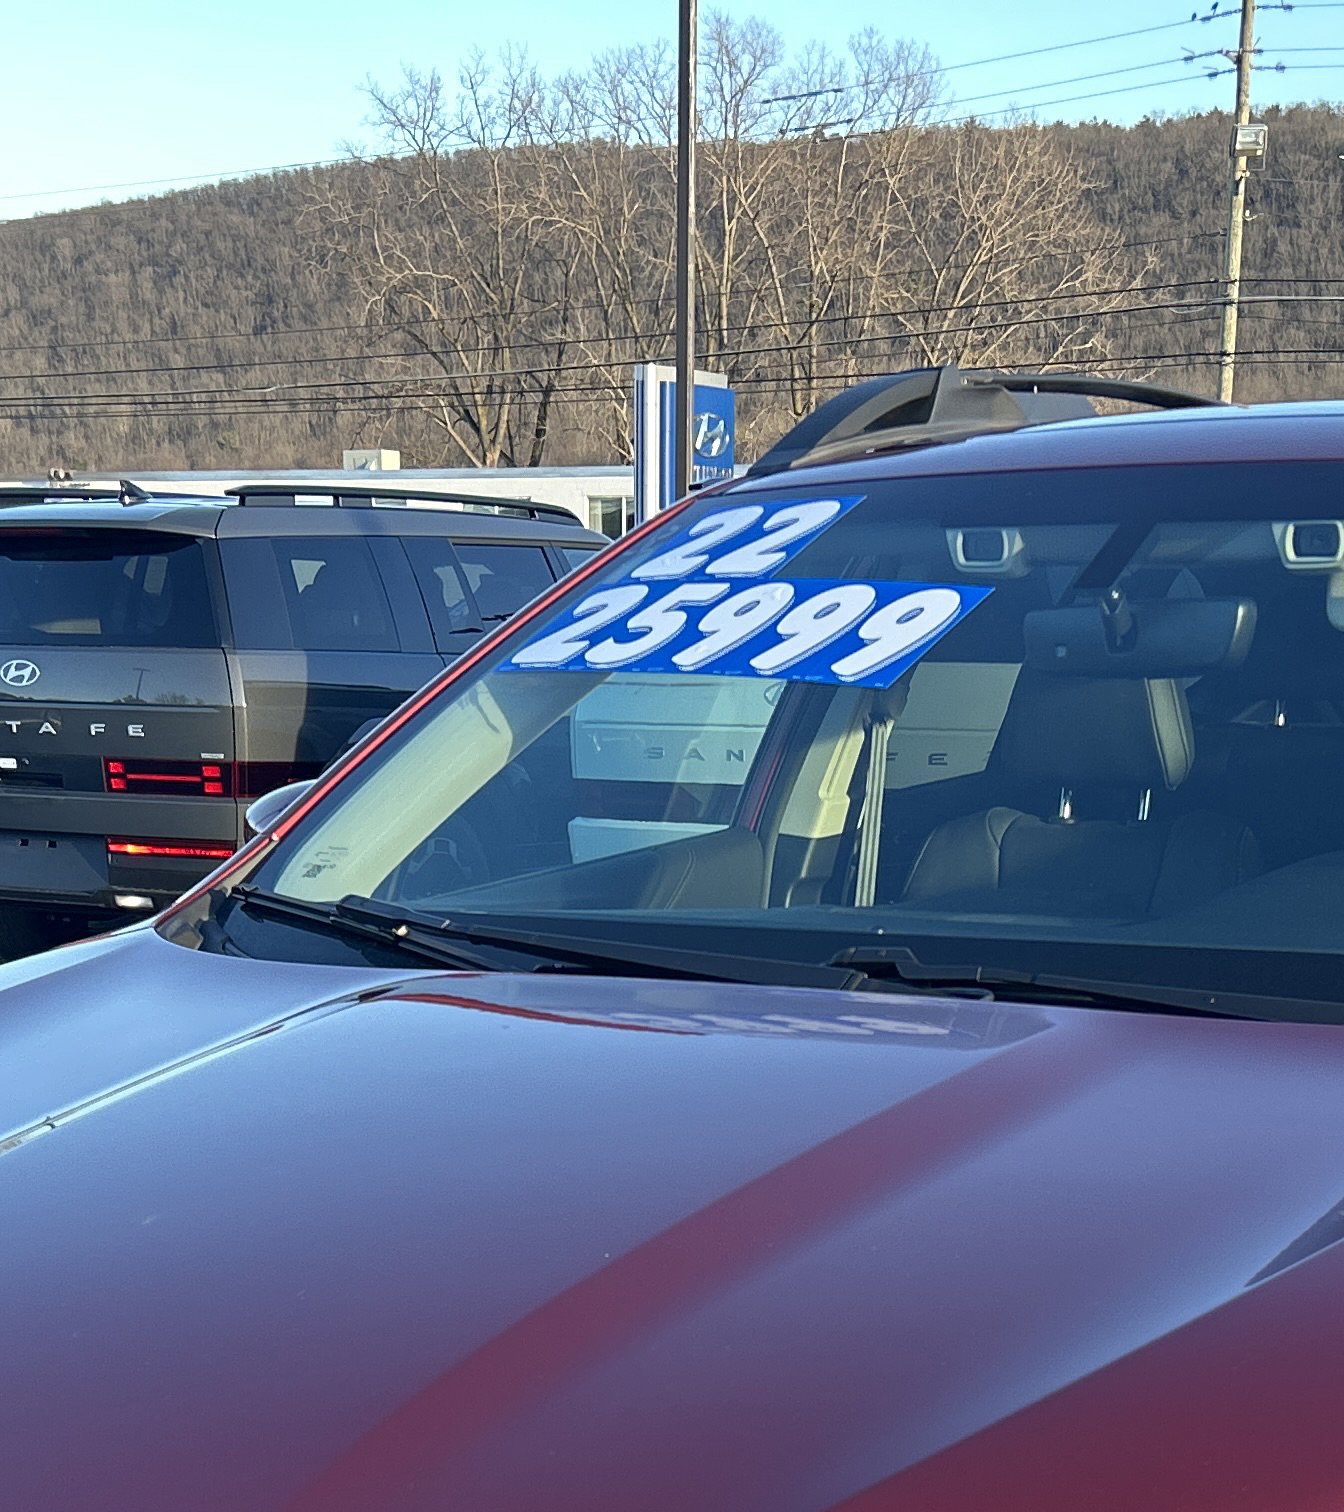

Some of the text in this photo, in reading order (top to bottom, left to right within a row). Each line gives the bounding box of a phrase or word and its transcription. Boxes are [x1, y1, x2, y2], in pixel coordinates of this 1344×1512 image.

[630, 500, 841, 581] 22
[511, 582, 962, 682] 25999
[90, 723, 146, 737] FE
[644, 747, 746, 763] SAN
